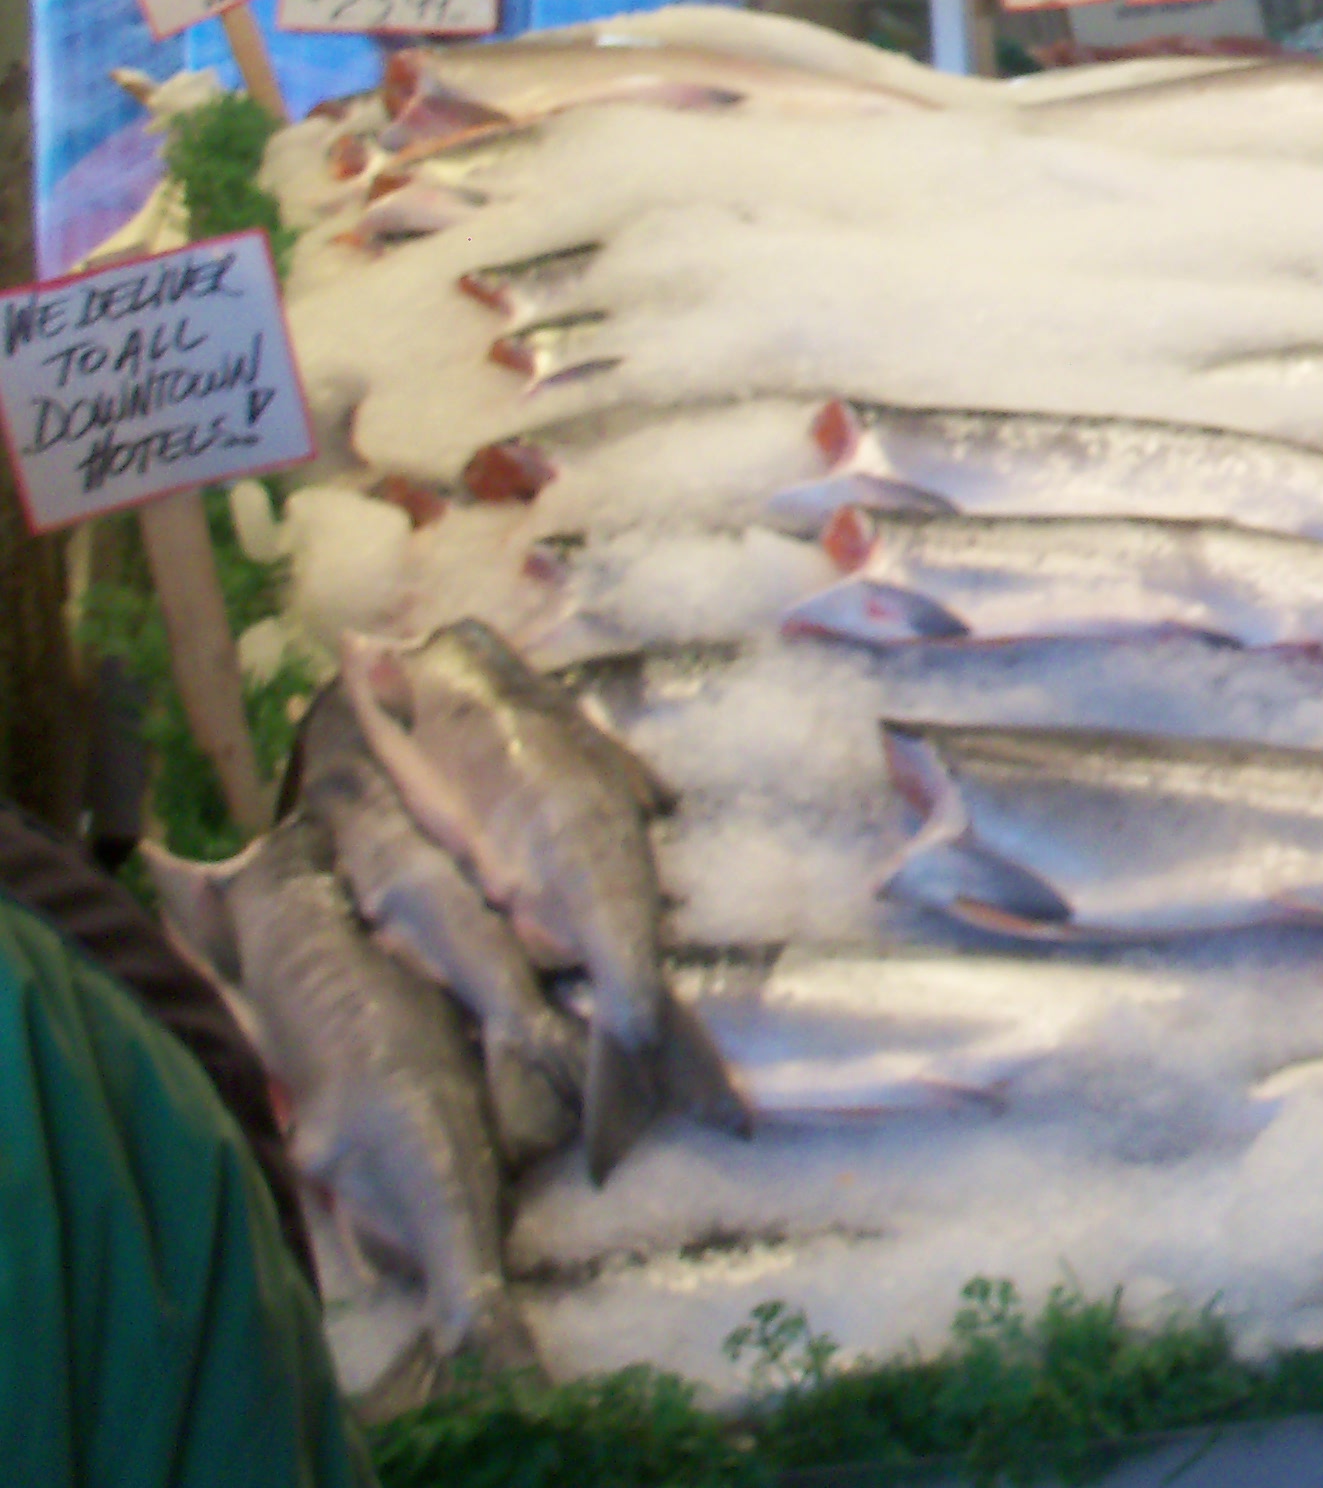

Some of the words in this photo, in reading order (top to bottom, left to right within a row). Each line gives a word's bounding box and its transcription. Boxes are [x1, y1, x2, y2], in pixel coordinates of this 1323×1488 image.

[2, 292, 68, 356] WE
[75, 252, 244, 330] DELIVER
[42, 340, 107, 387] TO
[115, 316, 208, 376] ALL
[23, 332, 263, 455] DOWNTOWN
